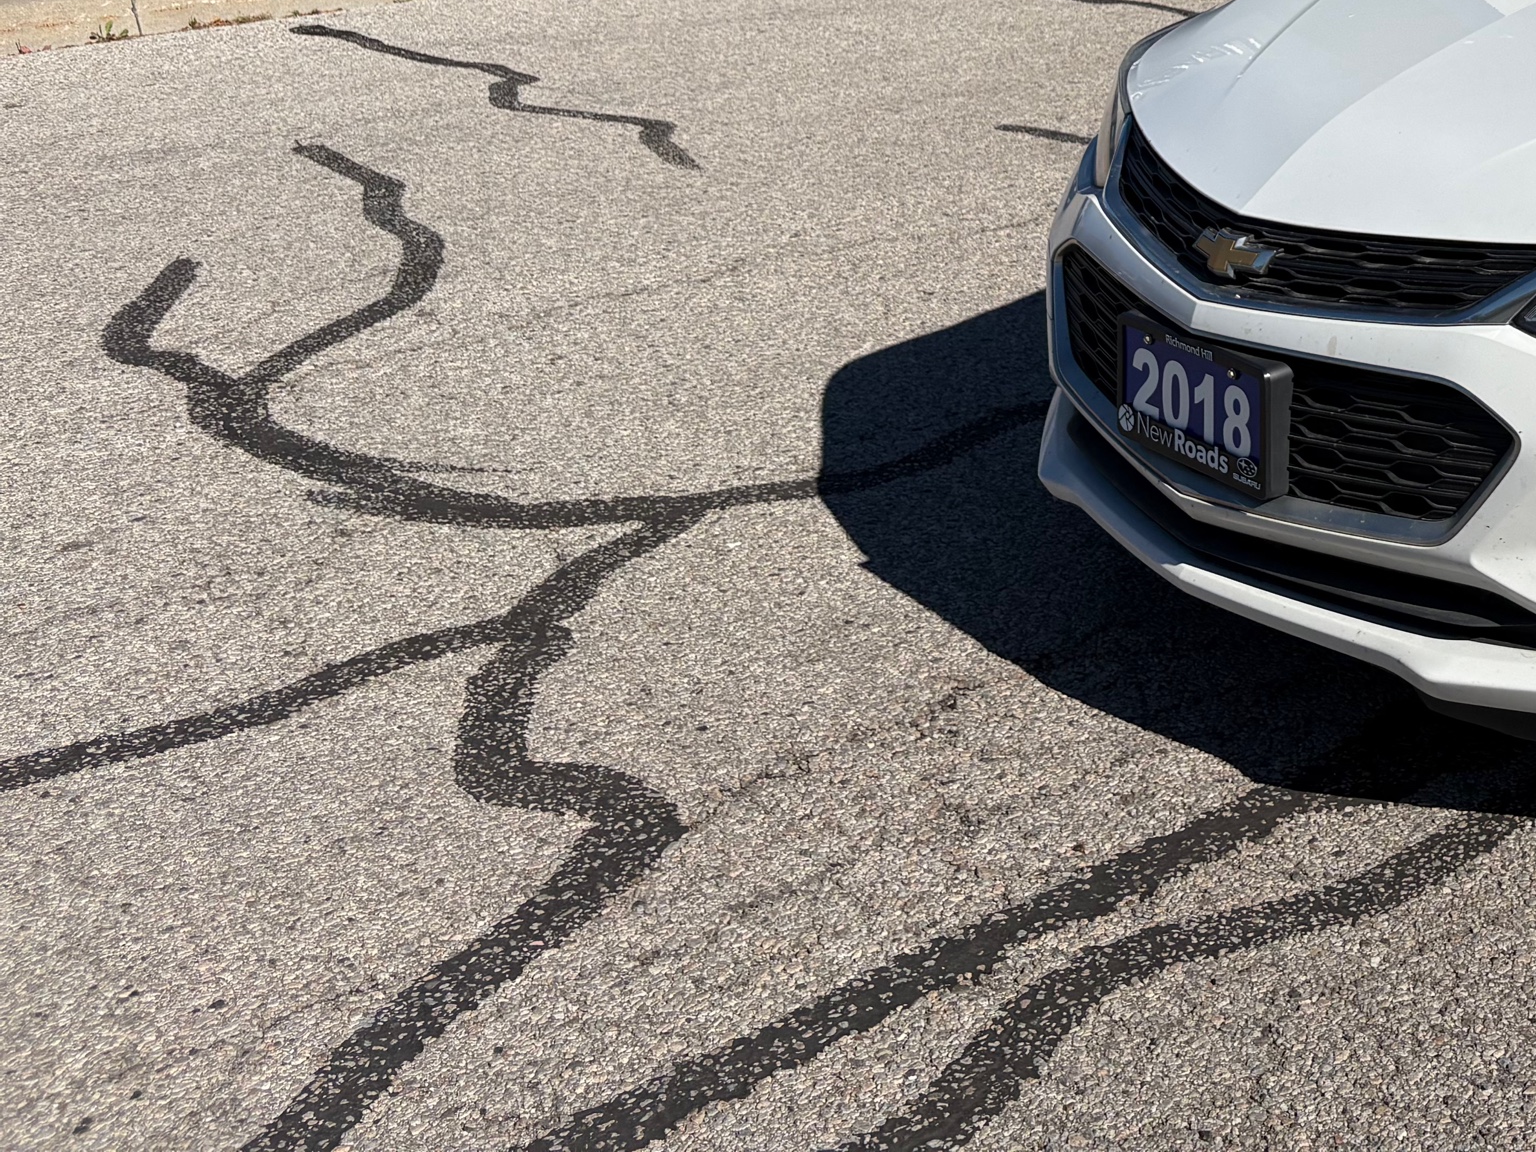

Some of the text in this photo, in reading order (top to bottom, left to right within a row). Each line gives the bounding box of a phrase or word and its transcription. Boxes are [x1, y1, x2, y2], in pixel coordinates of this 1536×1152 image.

[1165, 333, 1200, 357] Richmond
[1132, 348, 1251, 457] 2018
[1232, 472, 1261, 490] SUBARU
